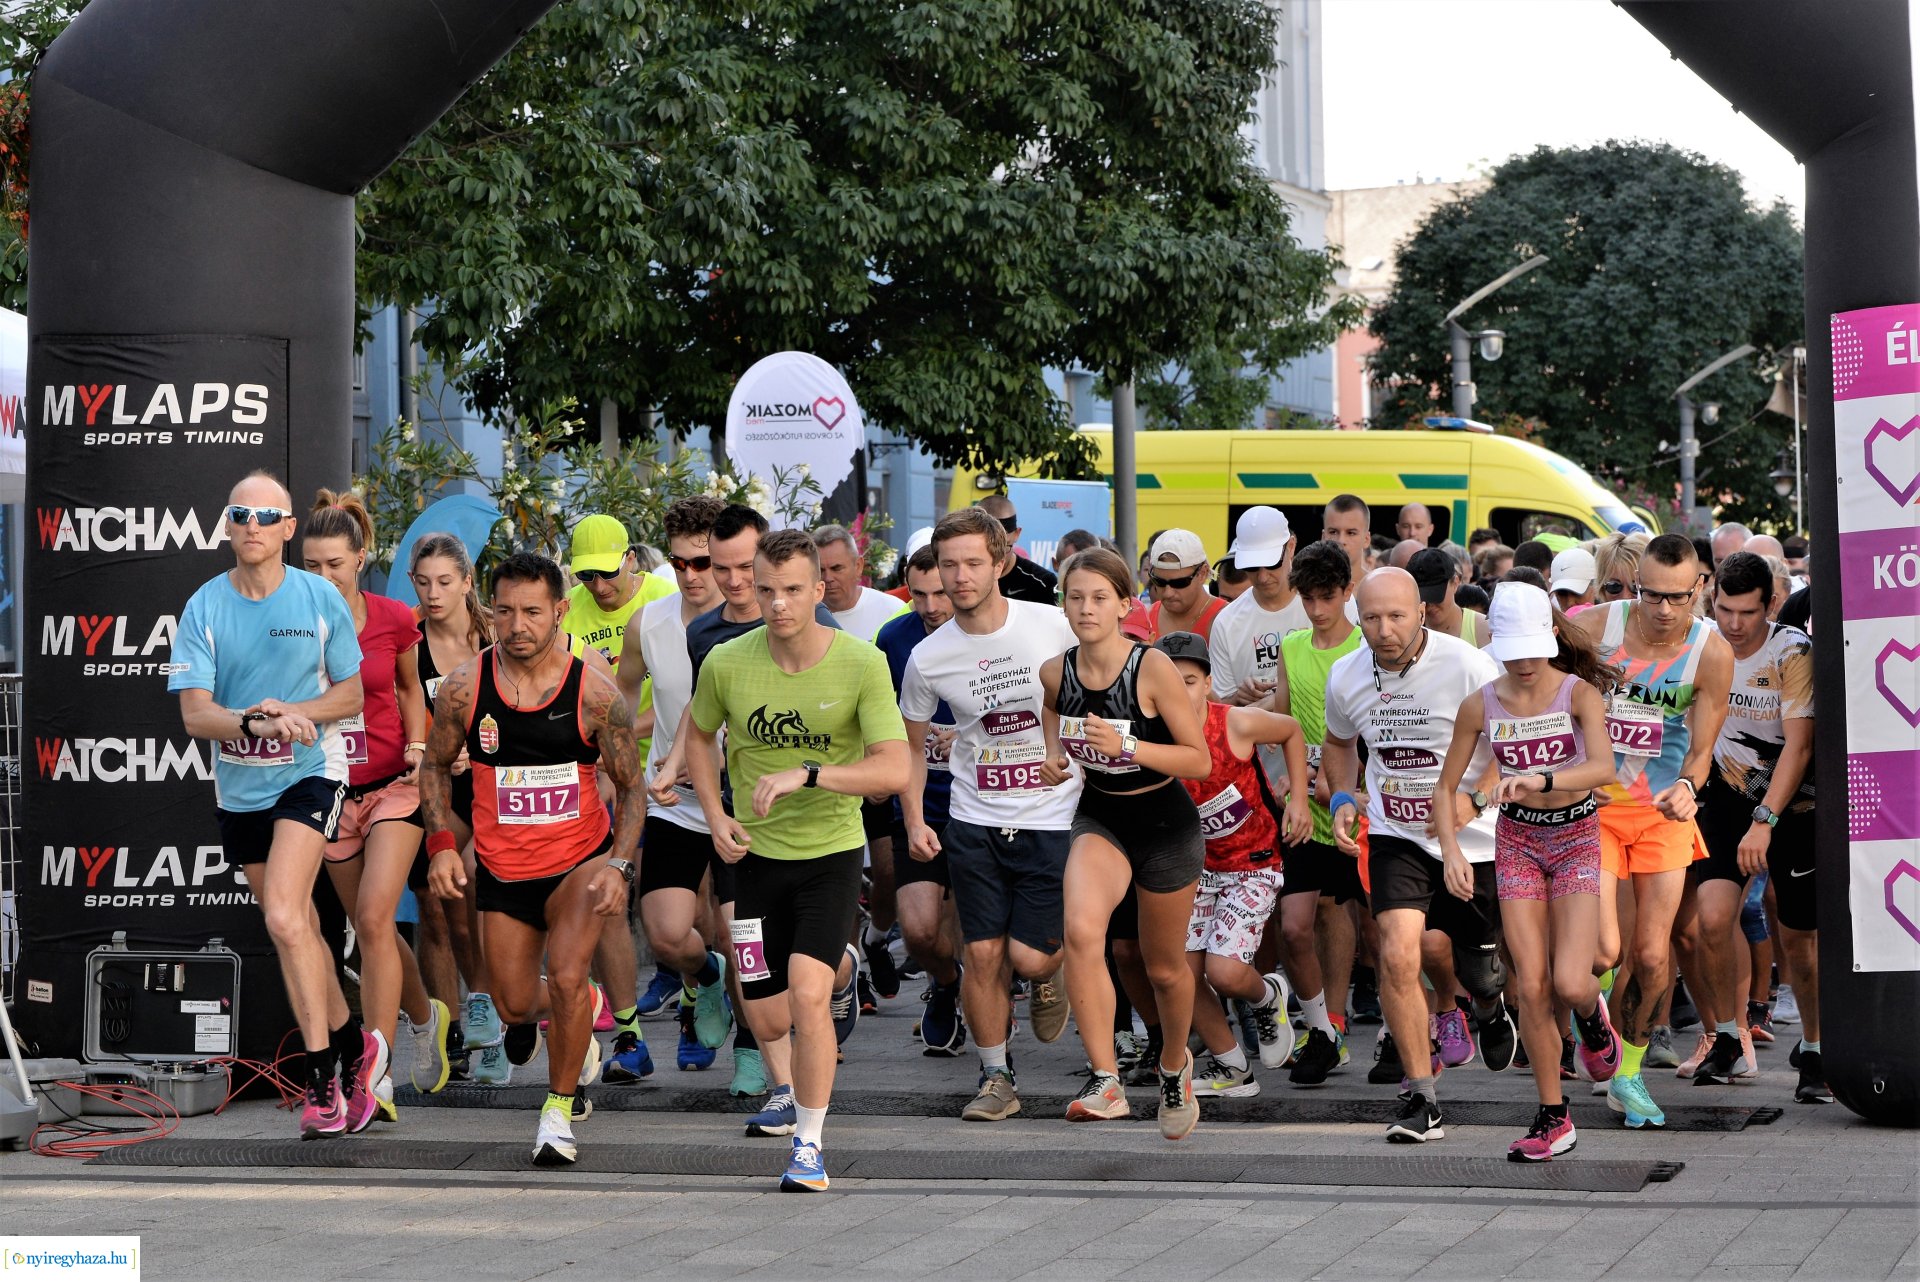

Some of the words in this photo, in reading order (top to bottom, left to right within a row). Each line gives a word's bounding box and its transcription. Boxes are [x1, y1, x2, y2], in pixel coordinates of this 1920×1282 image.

[43, 383, 269, 426] MYLAPS
[0, 393, 26, 439] WA
[83, 431, 173, 446] SPORTS
[184, 430, 264, 445] TIMING
[980, 666, 1031, 685] NYÍREGYHÁZI
[972, 675, 1032, 697] FUTÓFESZTIVÁL
[999, 714, 1010, 724] ÉN
[1011, 714, 1019, 722] IS
[1380, 707, 1430, 717] NYÍREGYHÁZI
[988, 719, 1036, 734] LEFUTOTTAM
[1372, 717, 1429, 727] FUTÓFESZTIVÁL
[1605, 720, 1652, 745] 072
[1395, 749, 1405, 758] ÉN
[1503, 740, 1567, 765] 5142
[1386, 757, 1433, 767] LEFUTOTTAM
[986, 765, 1042, 787] 5195
[509, 789, 570, 812] 5117
[1515, 809, 1566, 823] NIKE
[84, 894, 174, 907] SPORTS
